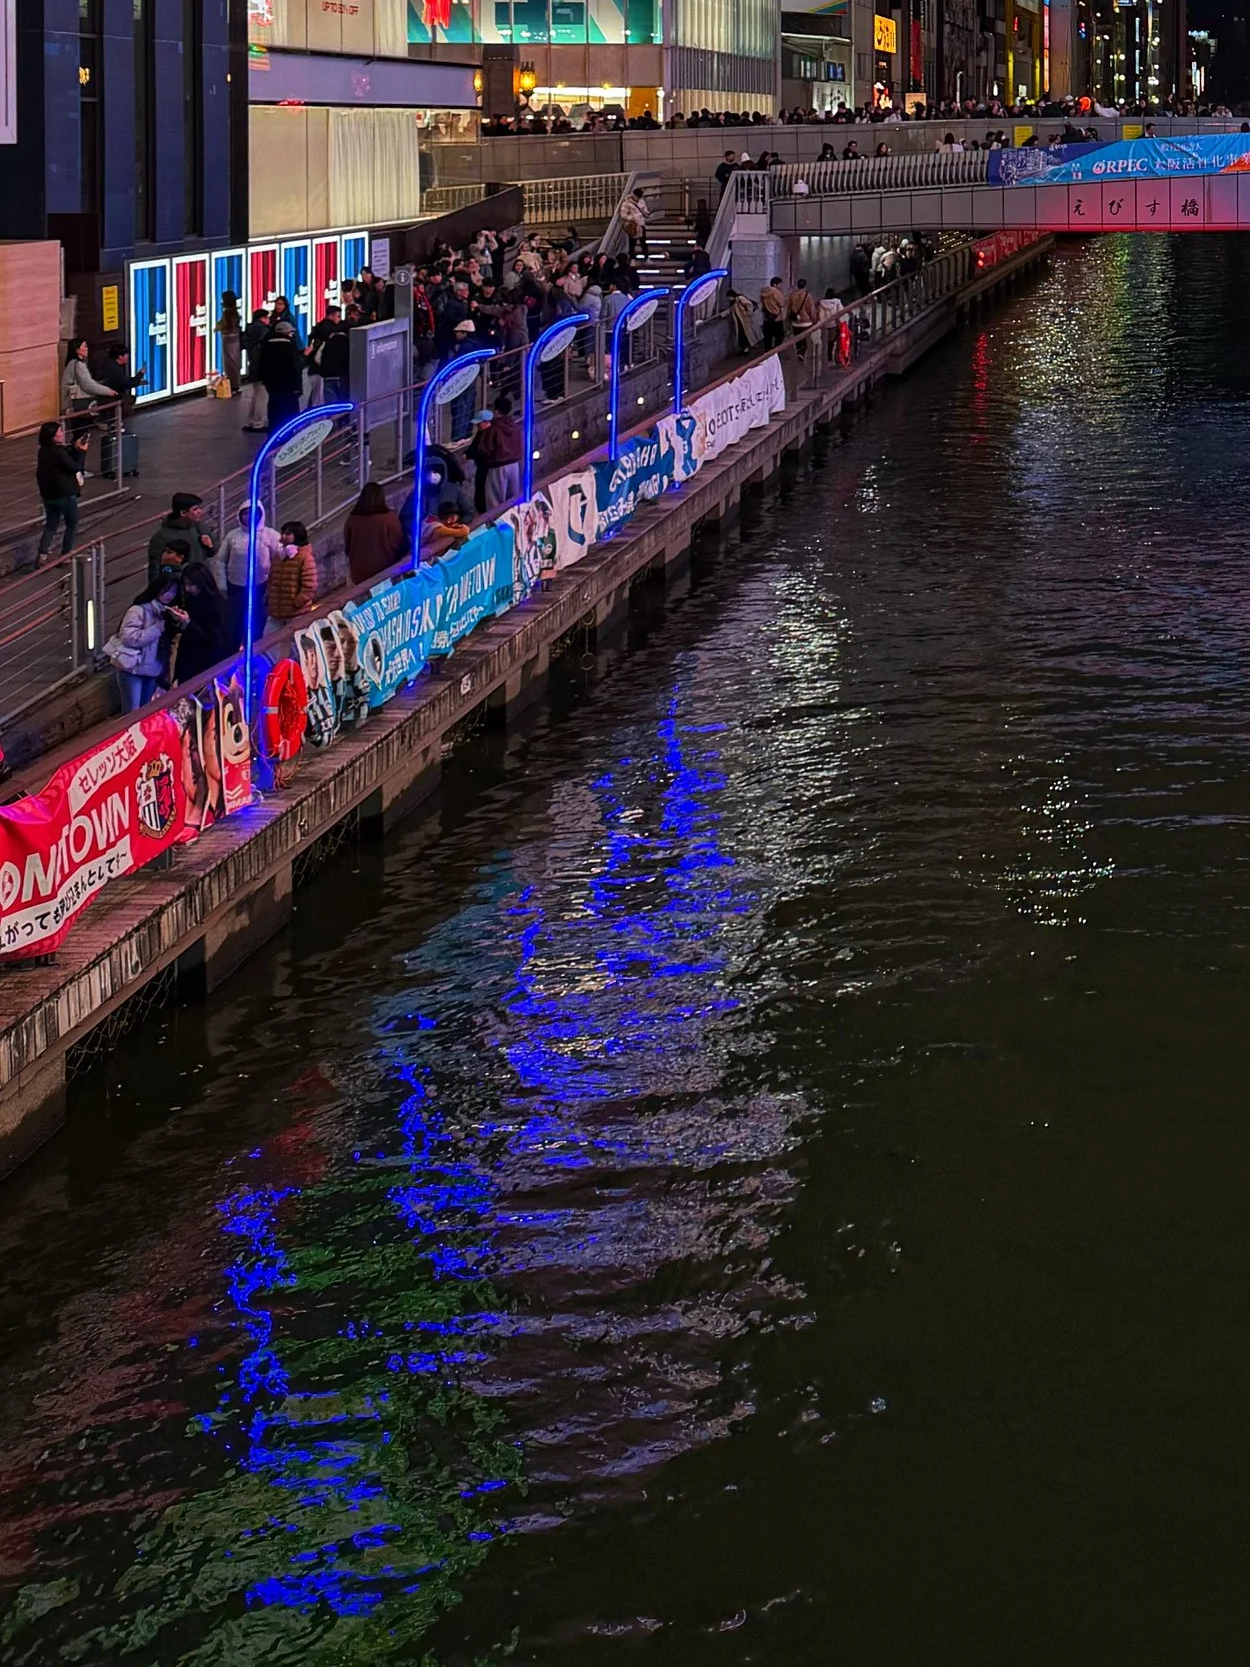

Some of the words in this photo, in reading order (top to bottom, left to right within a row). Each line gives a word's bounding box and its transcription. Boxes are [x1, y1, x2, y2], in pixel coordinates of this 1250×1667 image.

[1073, 197, 1200, 217] えびす橋
[79, 736, 137, 793] セレッソ大阪
